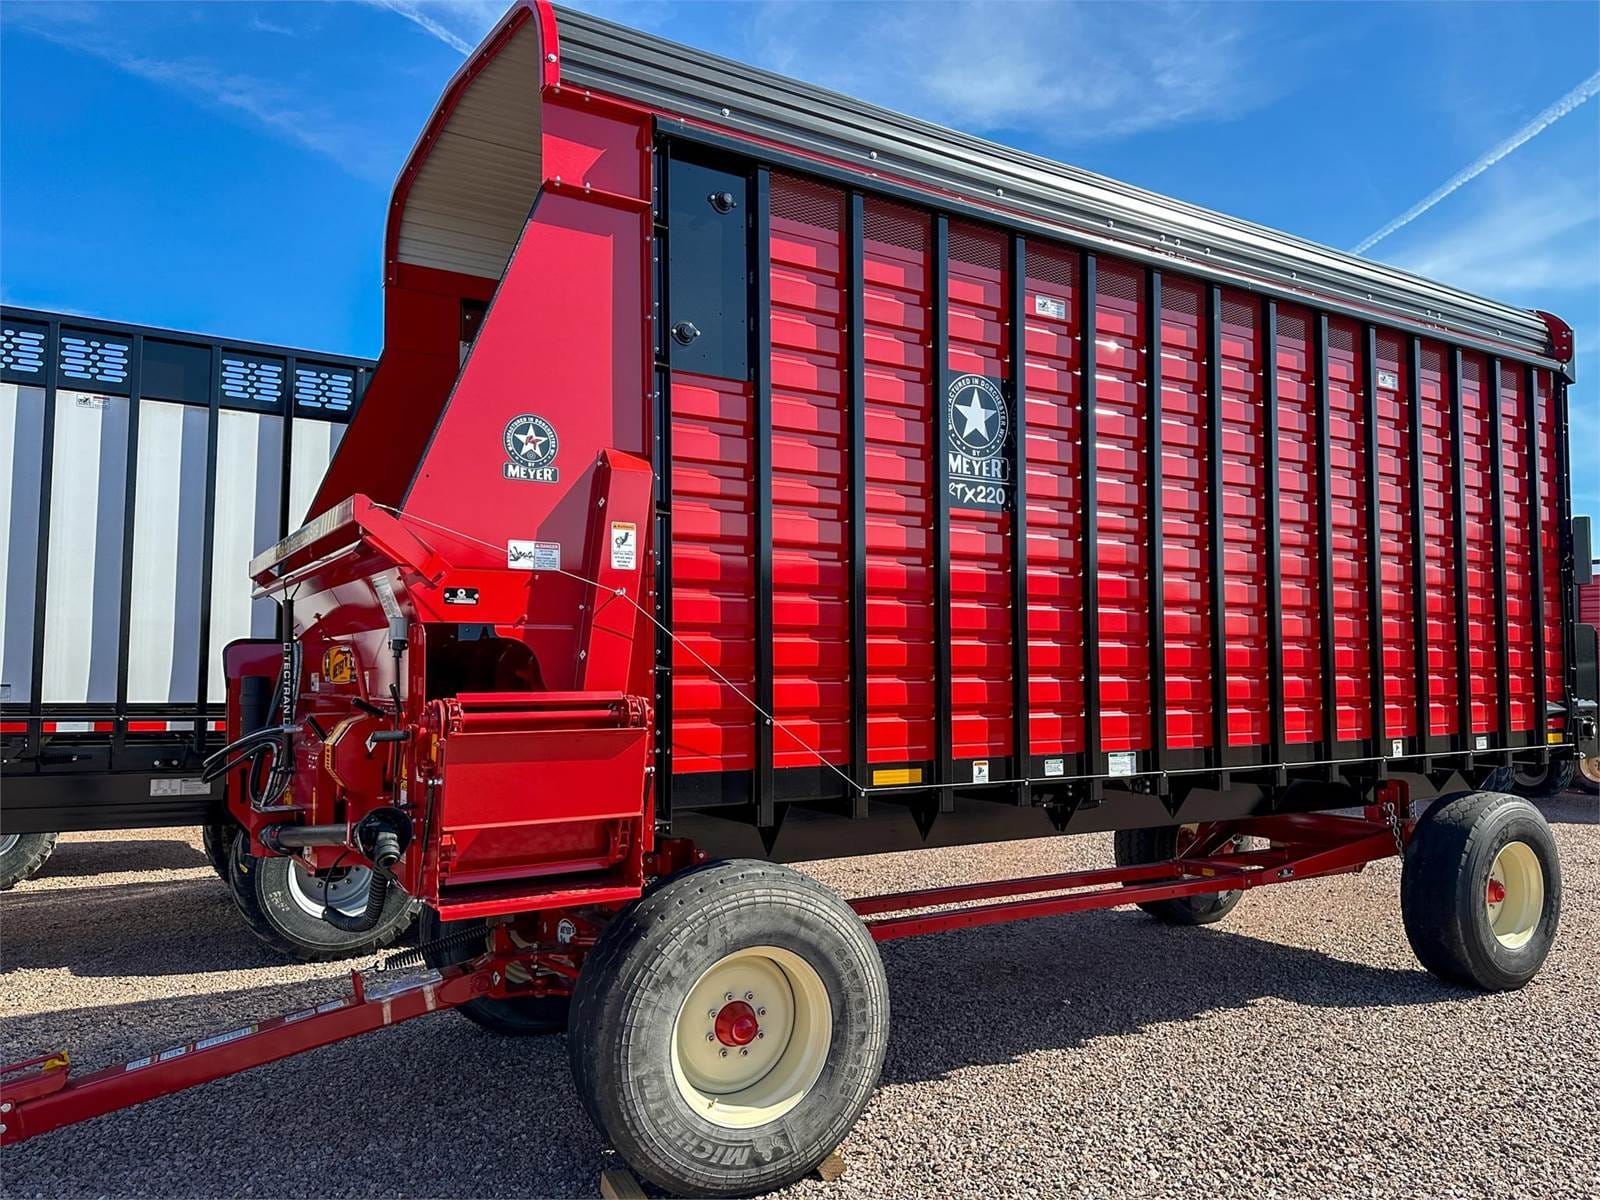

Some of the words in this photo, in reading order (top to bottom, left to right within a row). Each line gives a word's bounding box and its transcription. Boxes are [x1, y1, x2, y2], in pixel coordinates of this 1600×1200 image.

[972, 377, 979, 385] IN
[980, 379, 1006, 426] DORCHESTER
[507, 464, 553, 481] MEYER
[949, 453, 1002, 478] MEYER
[283, 655, 291, 714] TECTRAN
[642, 1079, 750, 1166] MICHELIN
